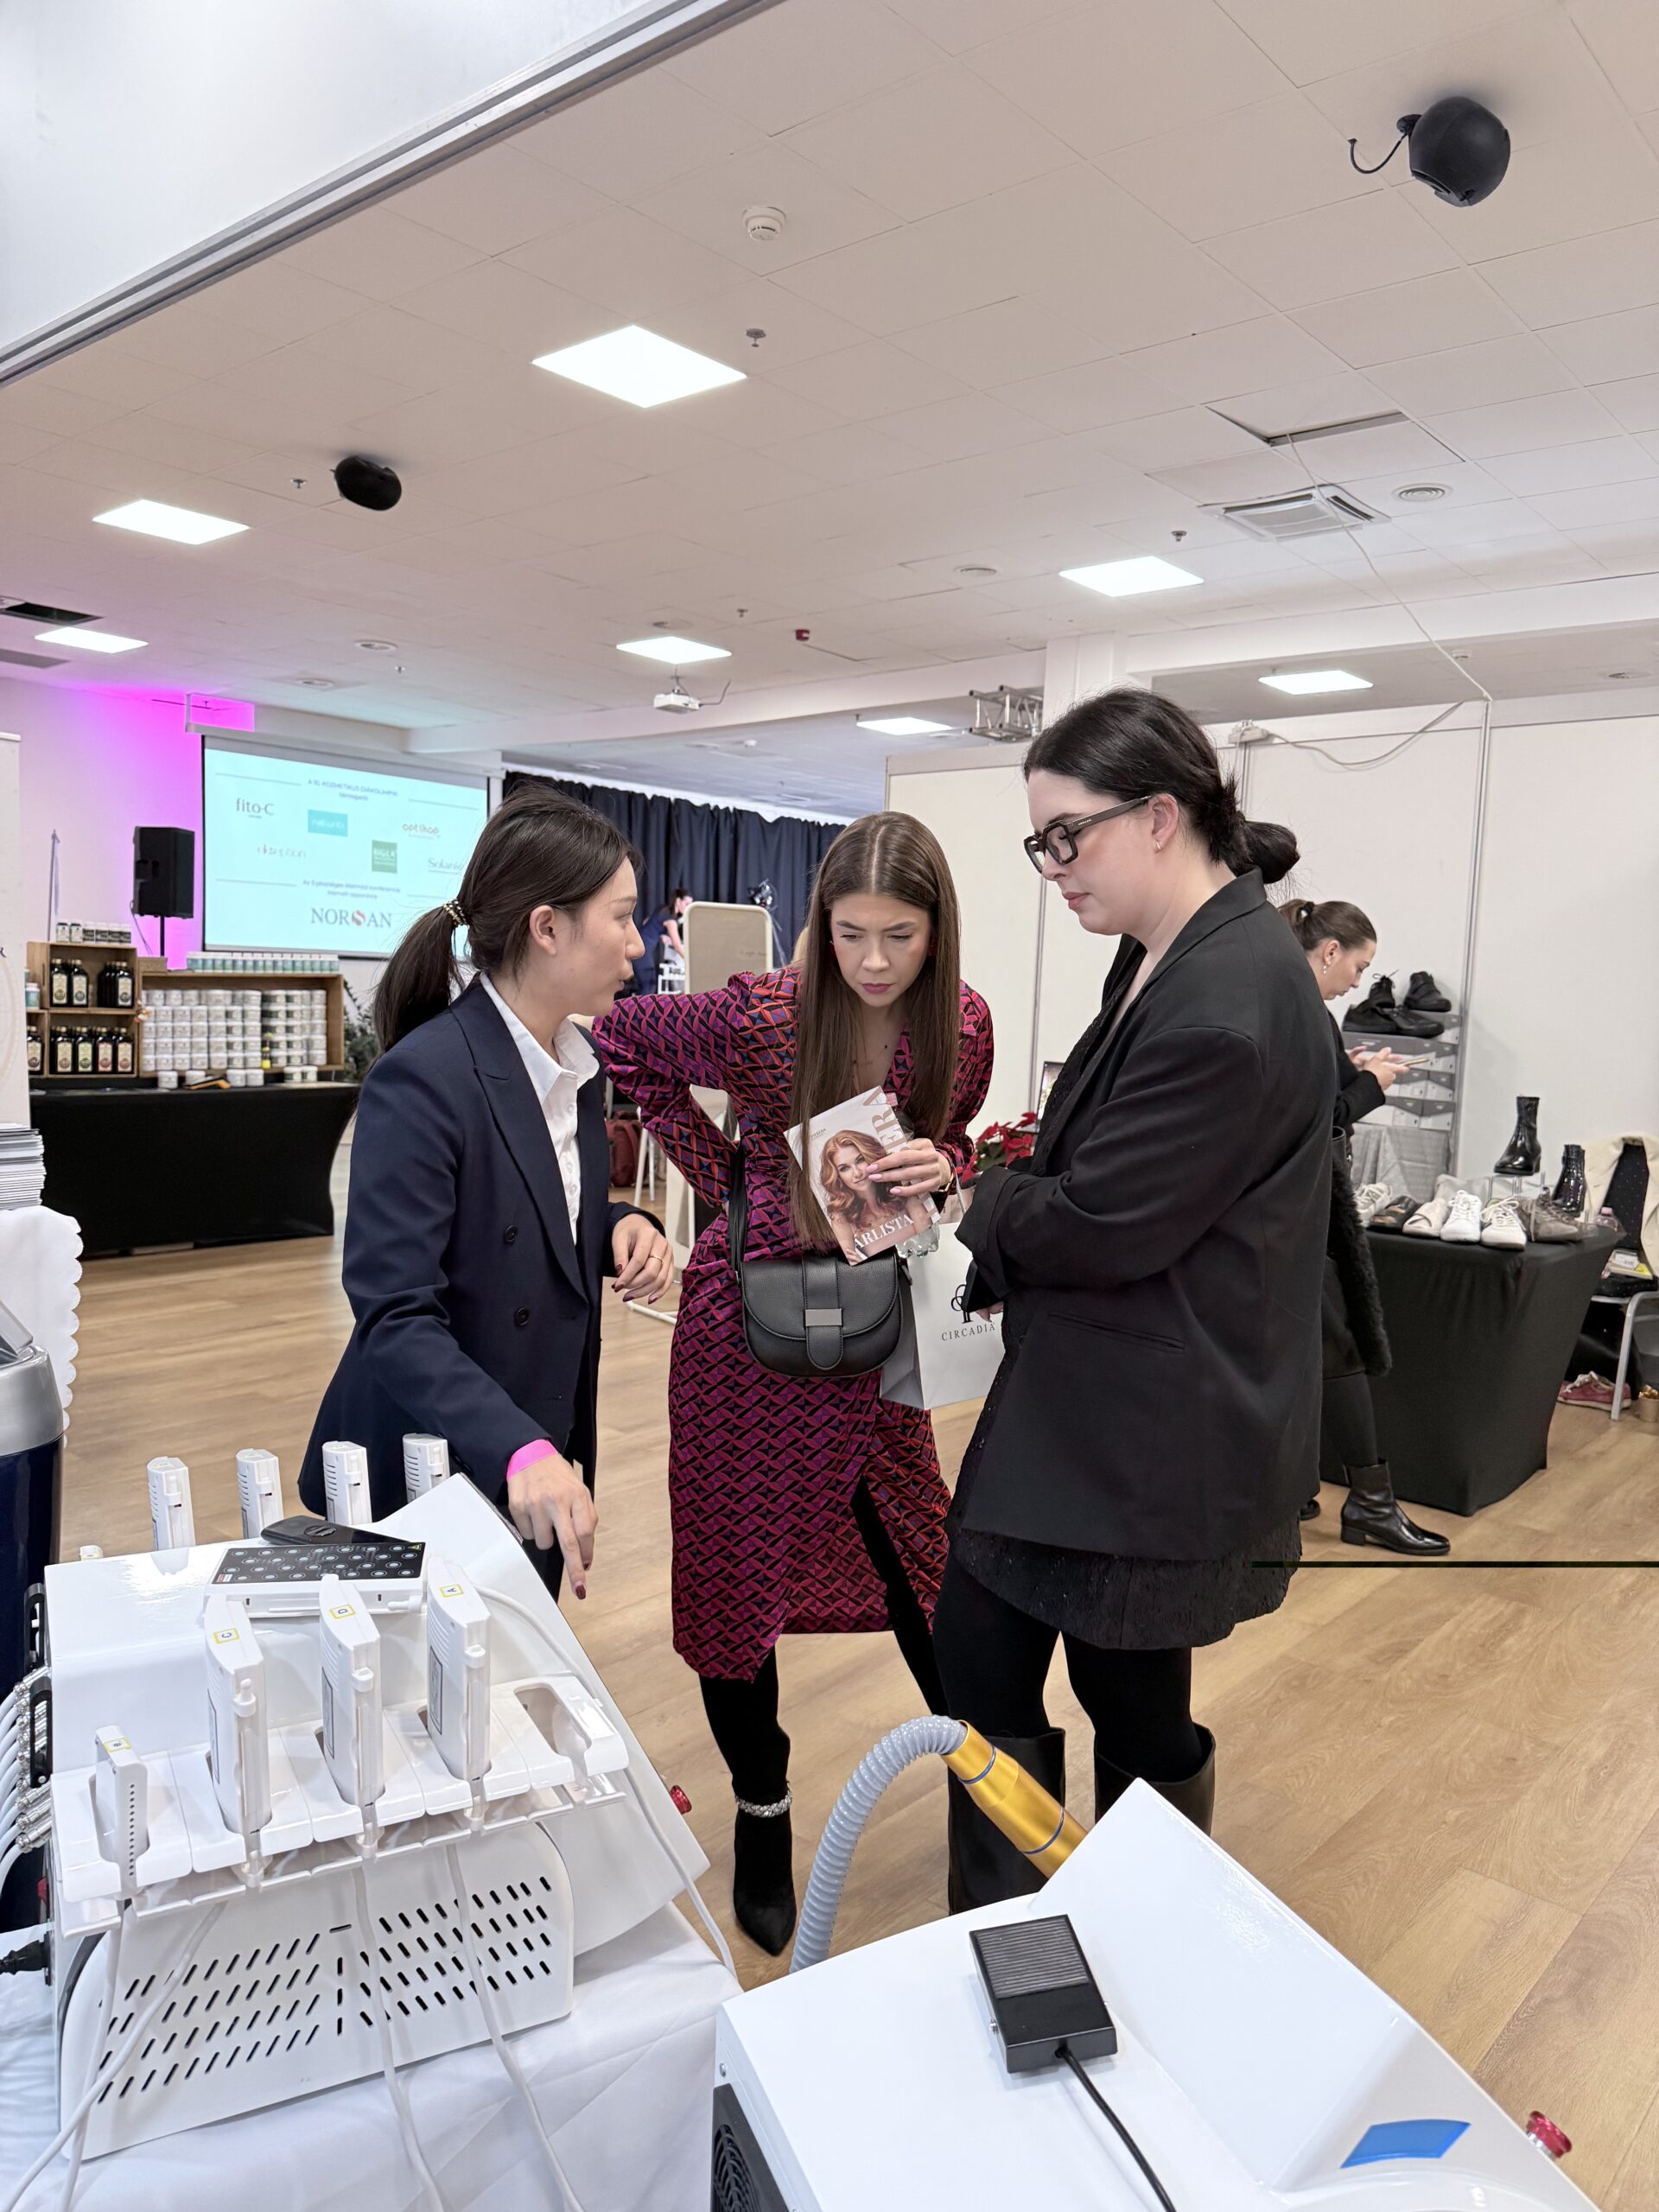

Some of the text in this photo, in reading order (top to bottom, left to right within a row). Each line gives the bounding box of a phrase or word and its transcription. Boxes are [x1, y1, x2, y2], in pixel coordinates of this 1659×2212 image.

[310, 907, 392, 928] NORSAN
[853, 1214, 914, 1249] ÁRLISTA
[941, 1323, 995, 1341] CIRCADIA
